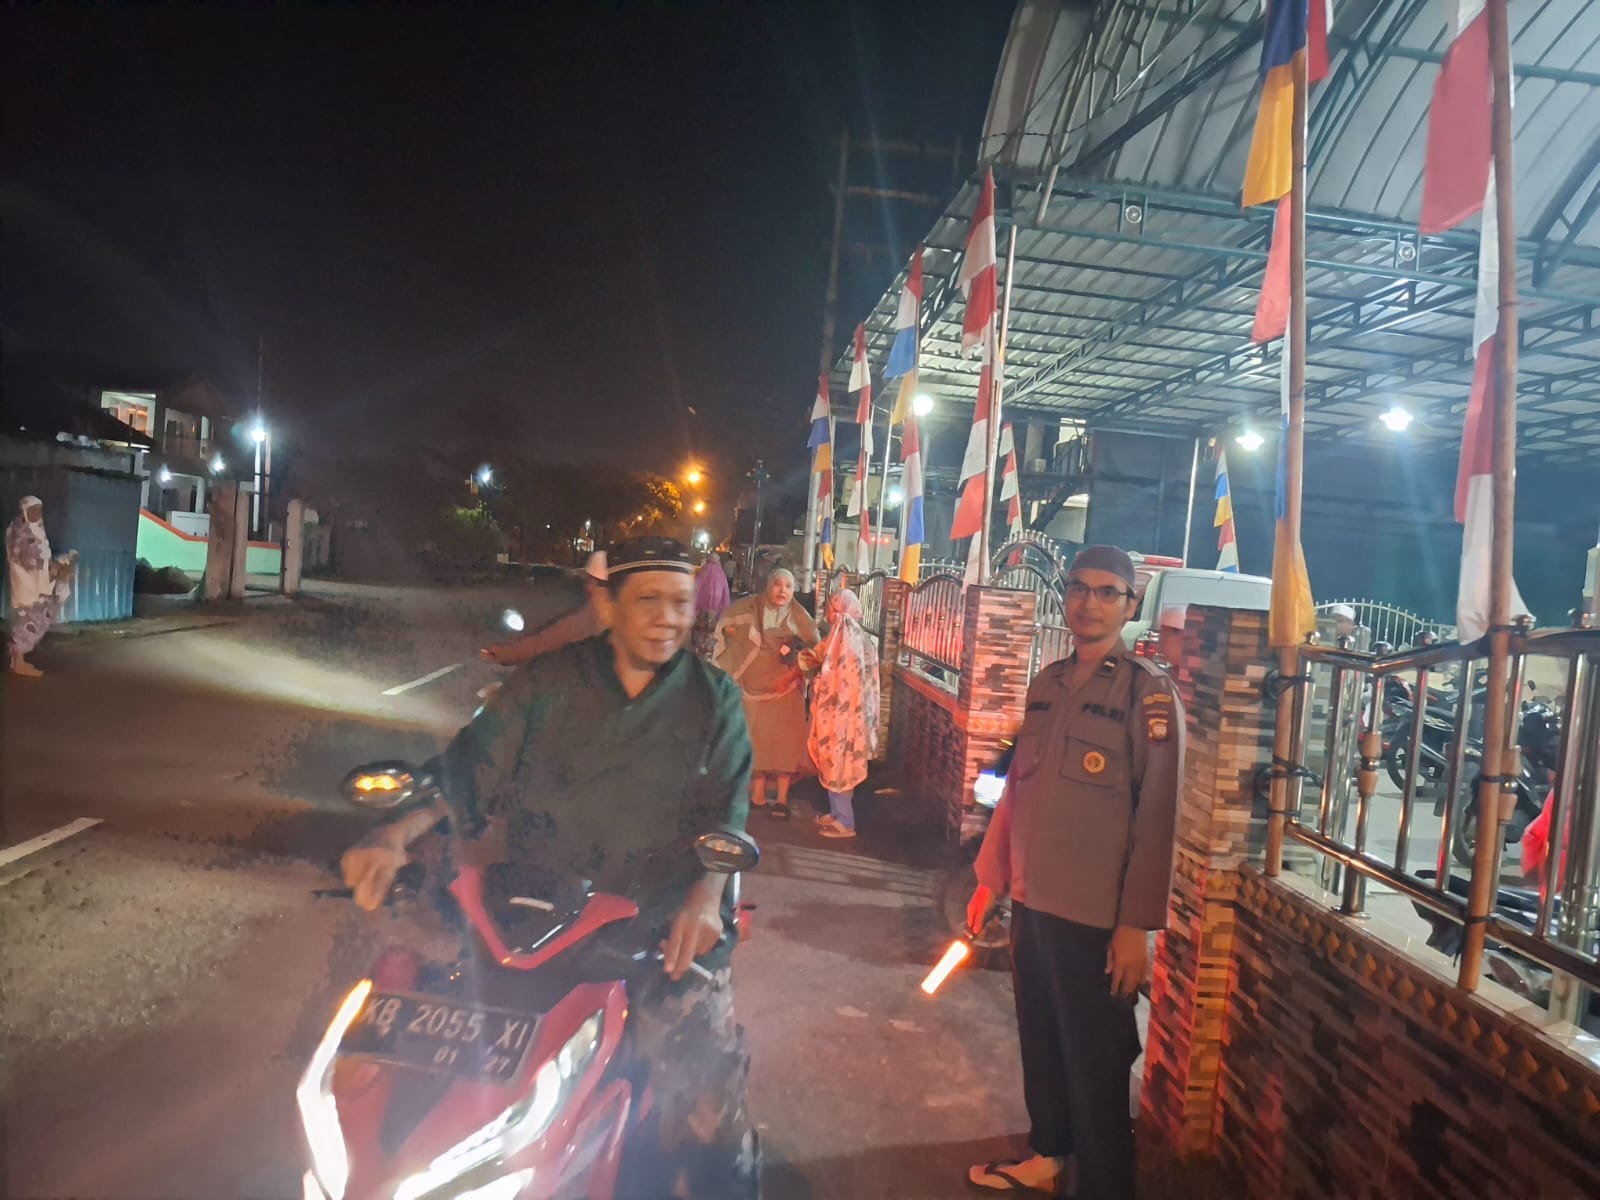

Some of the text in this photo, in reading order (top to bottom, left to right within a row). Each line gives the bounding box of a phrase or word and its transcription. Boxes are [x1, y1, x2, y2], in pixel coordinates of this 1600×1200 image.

[360, 998, 529, 1049] KB 2055 XI
[433, 1045, 459, 1065] 01
